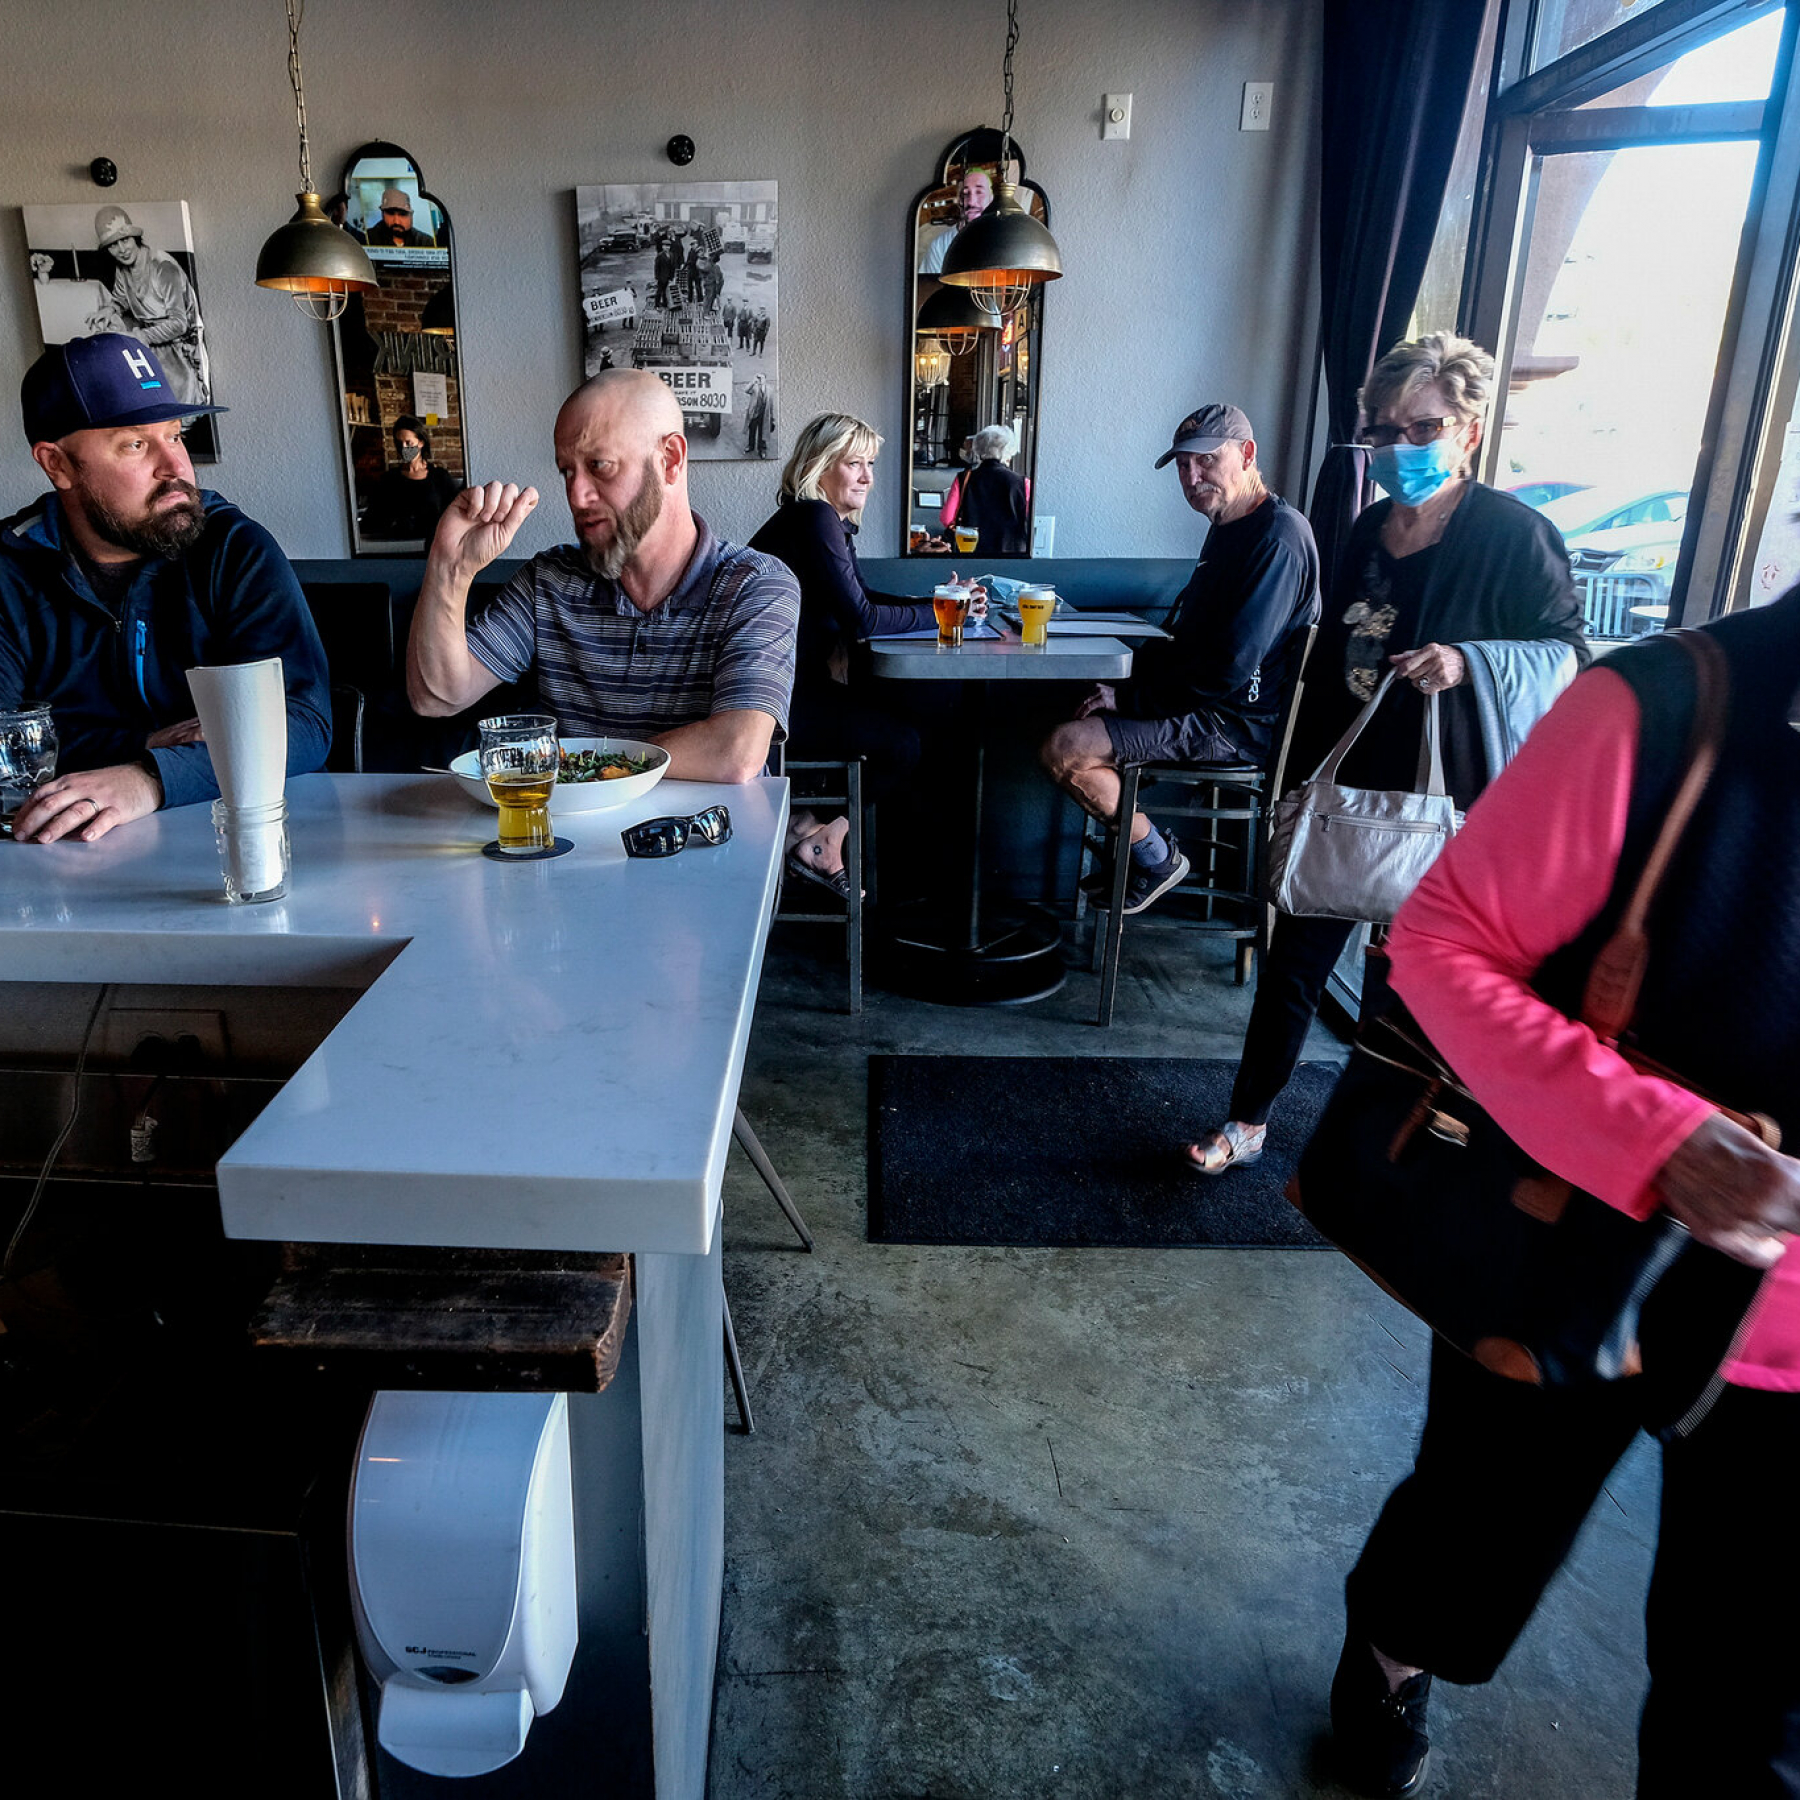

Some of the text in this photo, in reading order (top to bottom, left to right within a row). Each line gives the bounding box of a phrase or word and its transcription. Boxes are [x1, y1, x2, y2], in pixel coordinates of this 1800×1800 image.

[591, 297, 617, 311] BEER
[122, 348, 156, 379] H
[699, 392, 727, 408] 8030
